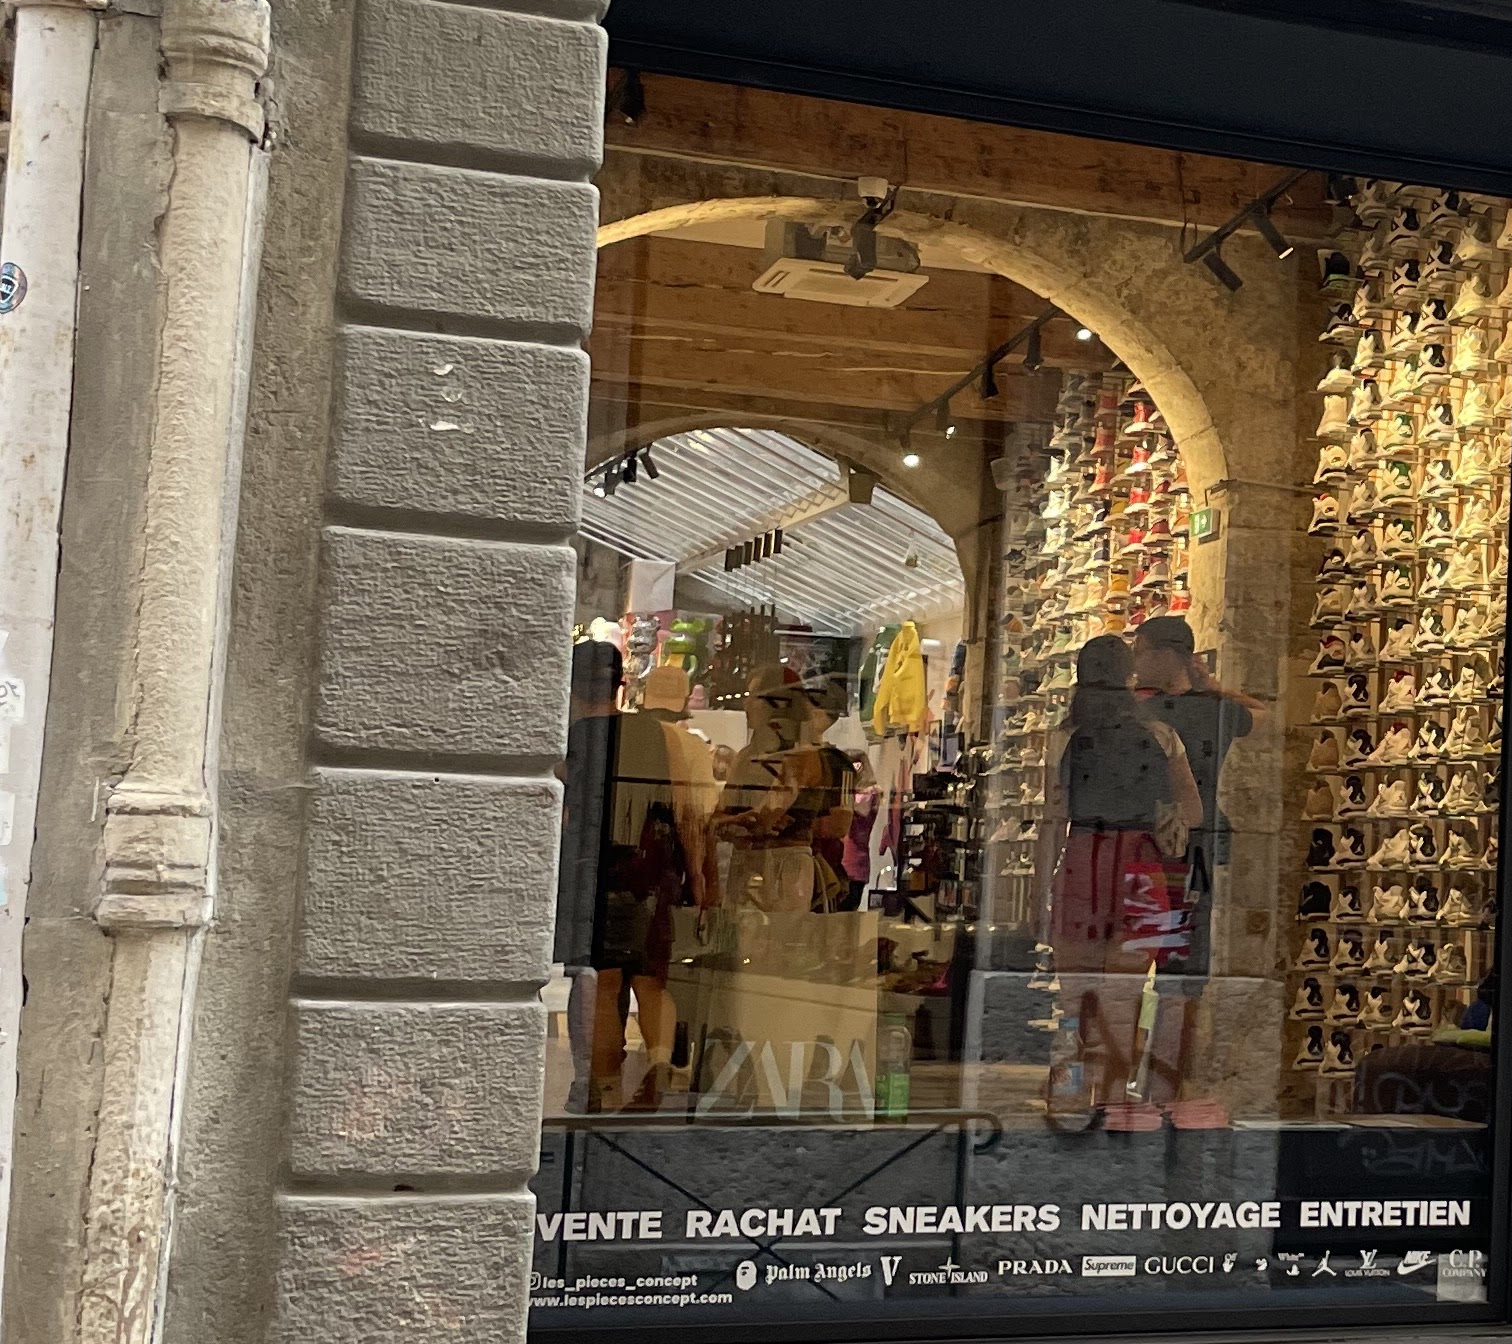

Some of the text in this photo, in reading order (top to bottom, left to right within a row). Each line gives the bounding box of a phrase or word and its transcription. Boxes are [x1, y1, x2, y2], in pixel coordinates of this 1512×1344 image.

[694, 1040, 876, 1122] ZARA
[537, 1200, 1471, 1242] VENTE RACHAT SNEAKERS NETTOYAGE ENTRETIEN
[1144, 1256, 1215, 1275] GUCCI
[1404, 1250, 1433, 1265] NIKE
[765, 1261, 872, 1285] Palm Angels
[998, 1259, 1073, 1275] PRADA
[1084, 1259, 1135, 1276] Supreme
[1442, 1267, 1488, 1278] COMPANY
[908, 1269, 988, 1286] STONE ISLAND
